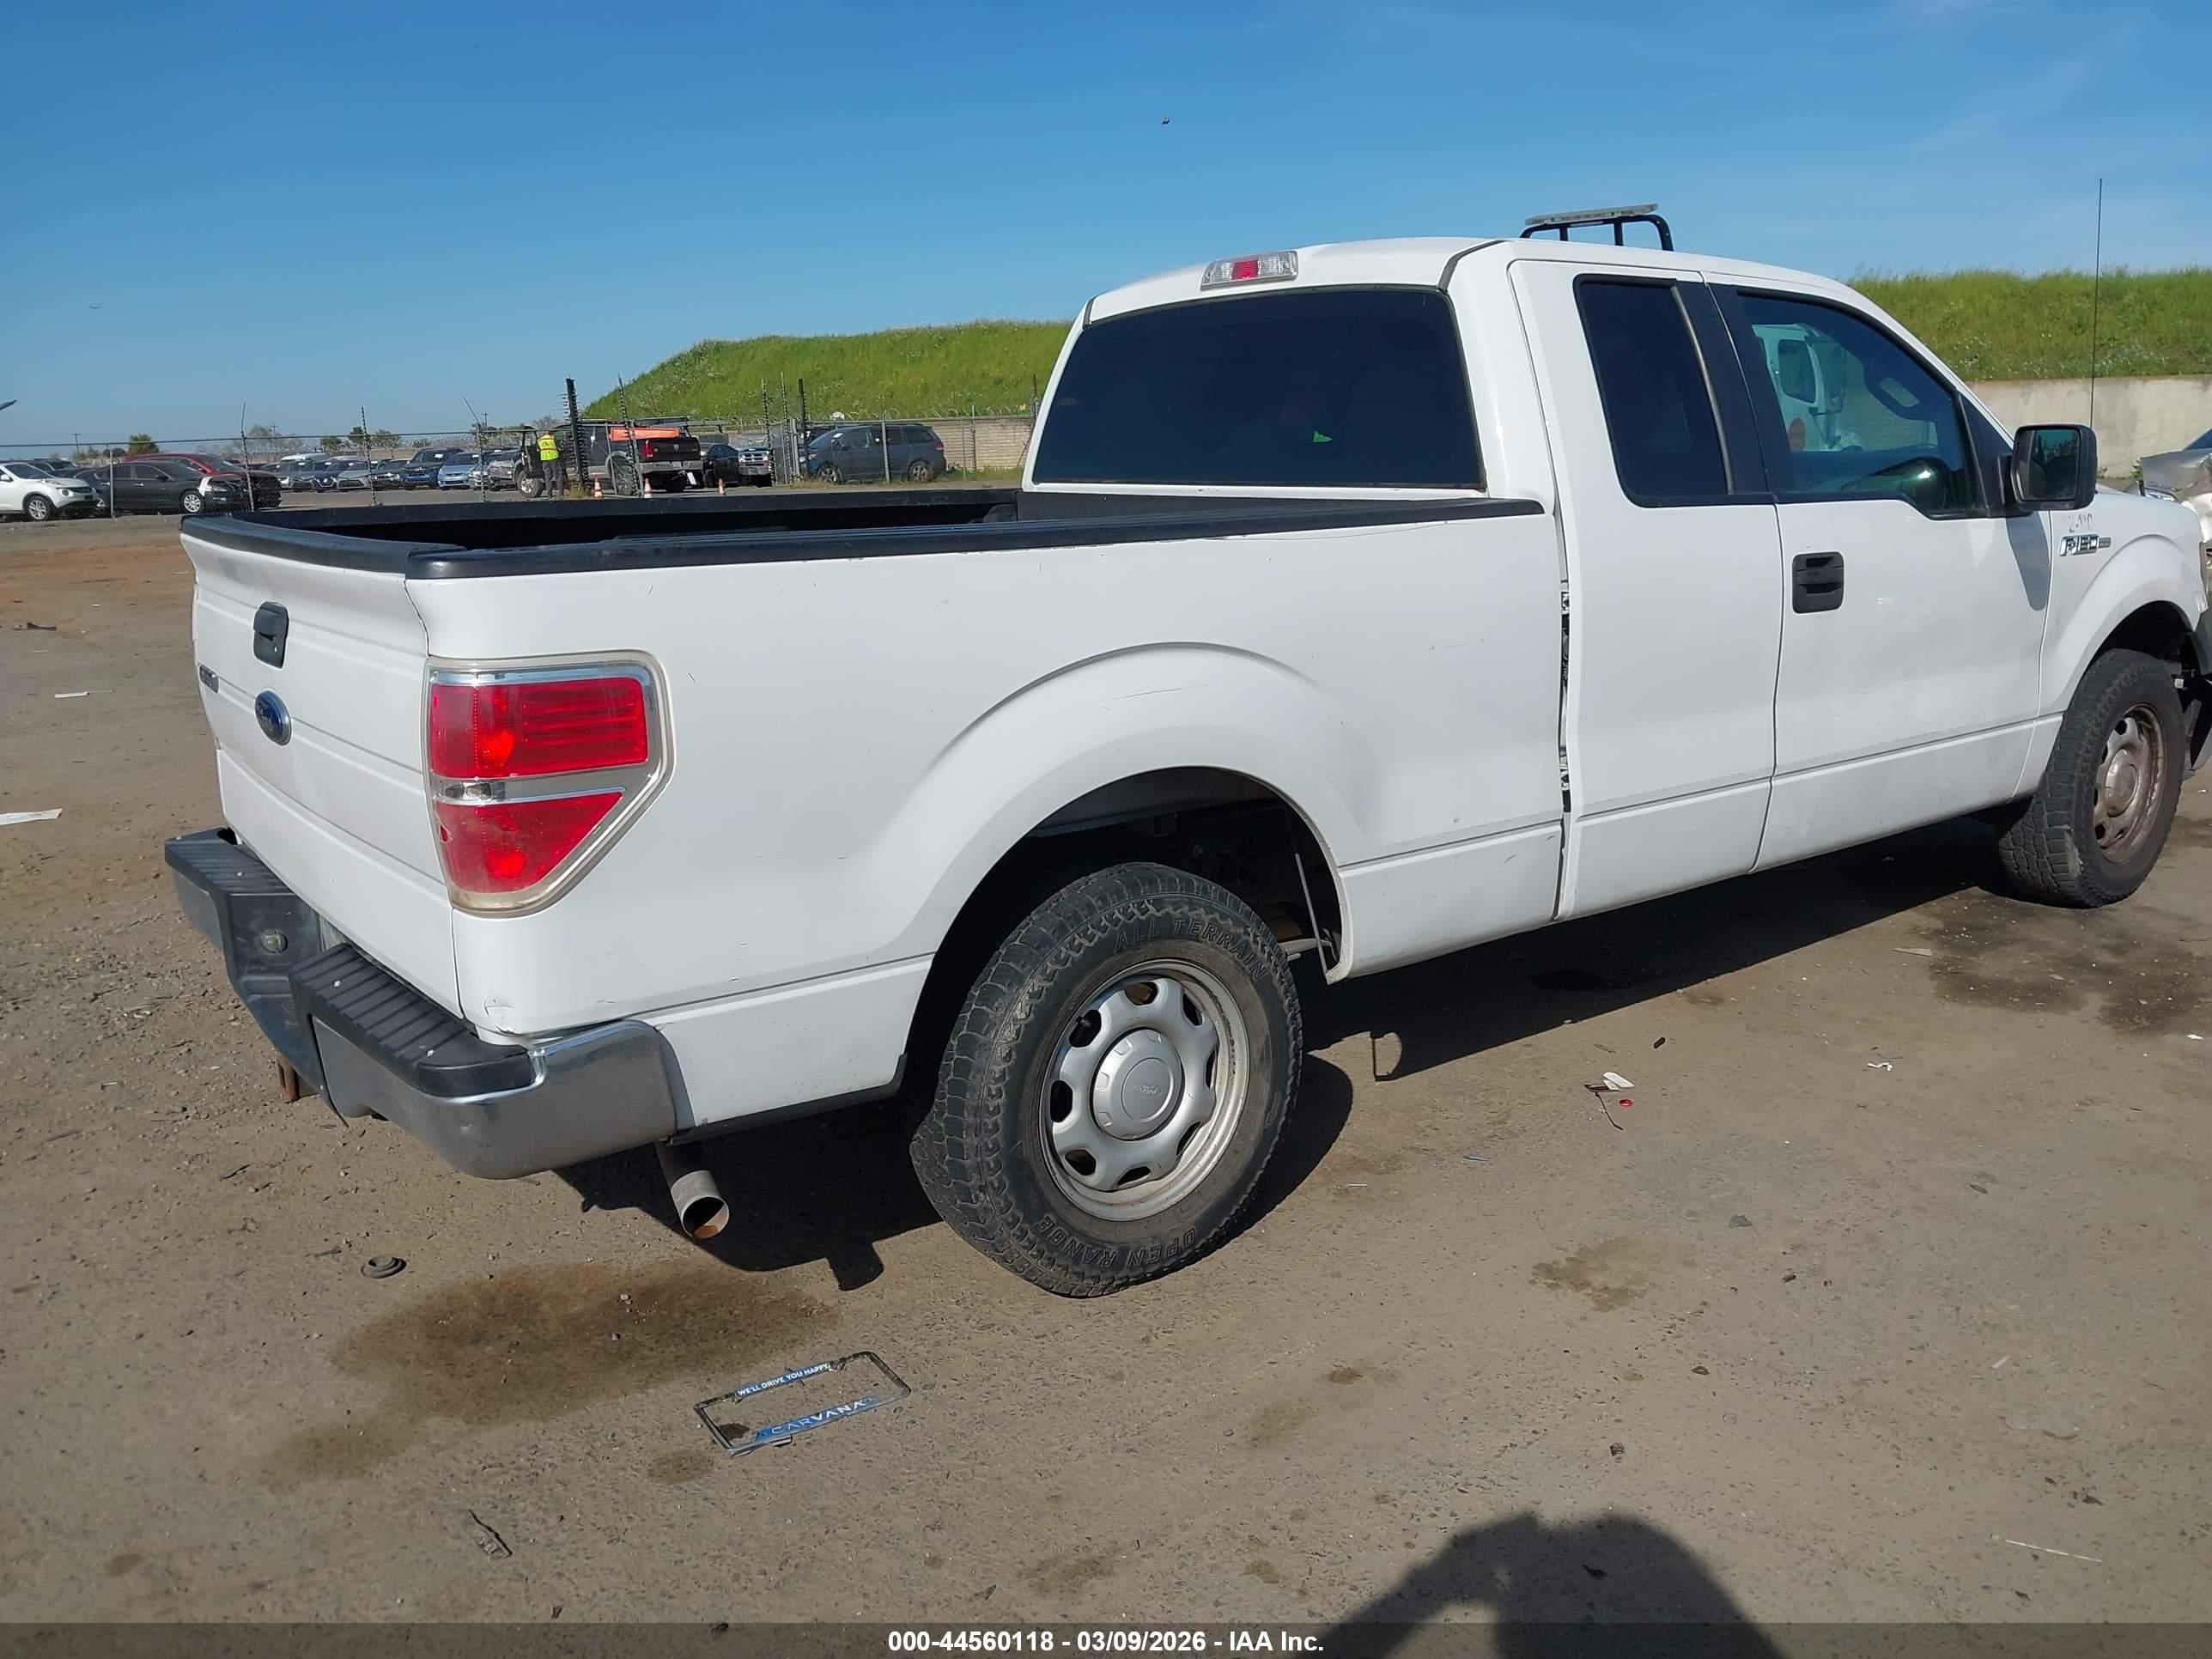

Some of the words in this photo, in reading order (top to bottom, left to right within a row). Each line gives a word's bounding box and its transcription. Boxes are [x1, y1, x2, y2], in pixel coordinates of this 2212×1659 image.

[1115, 920, 1161, 953] ALL
[1173, 918, 1268, 981] TERRAIN
[1036, 1212, 1117, 1269] RANGE
[1127, 1226, 1197, 1268] OPEN
[737, 1383, 761, 1397] WE'LL
[762, 1376, 786, 1389] DRIVE
[787, 1370, 804, 1381] YOU
[771, 1399, 866, 1435] CARVANA
